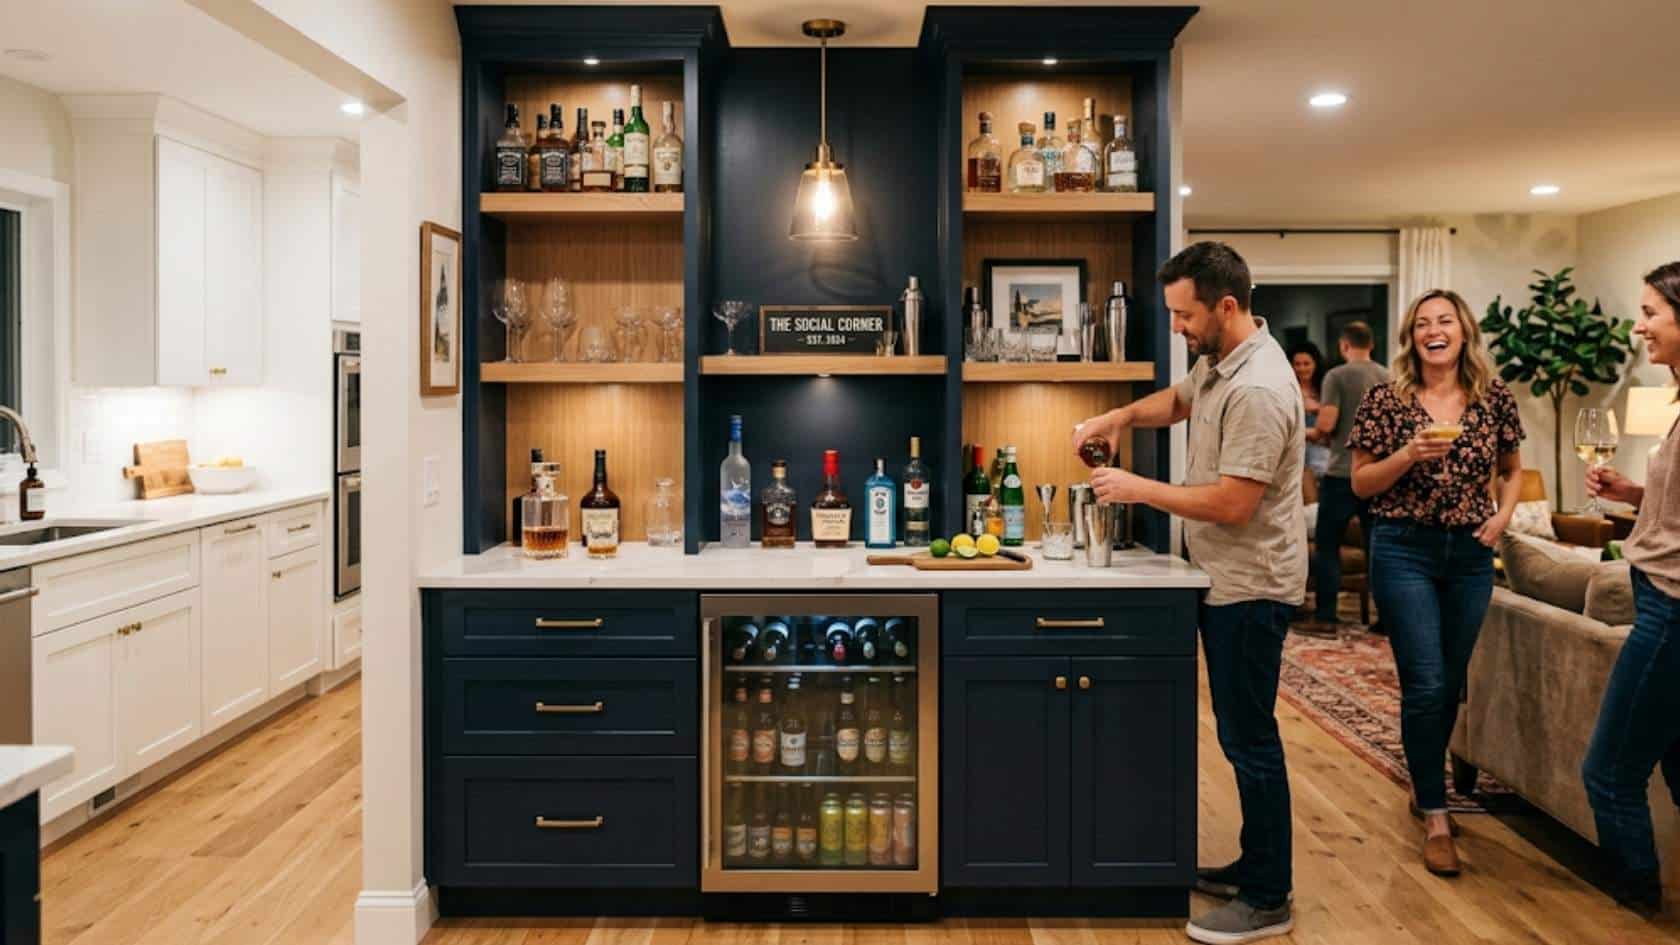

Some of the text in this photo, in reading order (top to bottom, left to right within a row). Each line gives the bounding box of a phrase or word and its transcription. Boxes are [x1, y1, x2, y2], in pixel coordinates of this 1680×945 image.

[770, 317, 883, 332] THE SOCIAL CORNER
